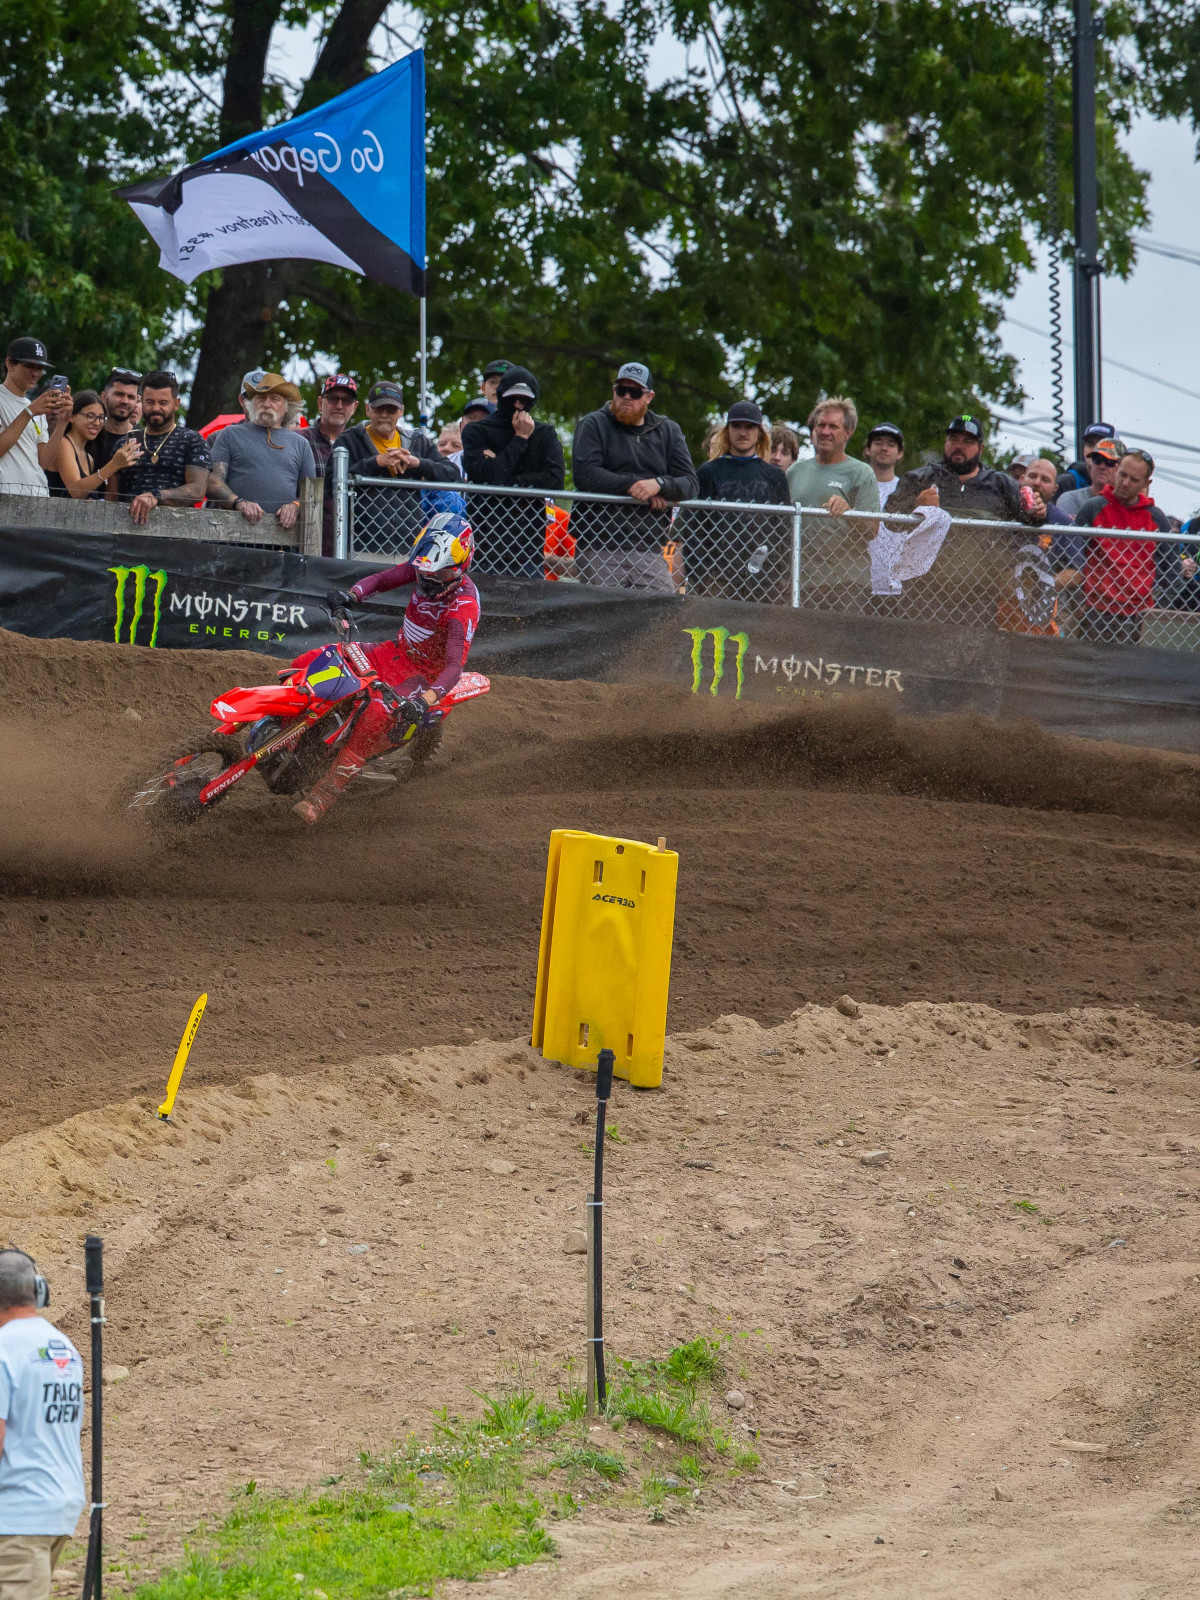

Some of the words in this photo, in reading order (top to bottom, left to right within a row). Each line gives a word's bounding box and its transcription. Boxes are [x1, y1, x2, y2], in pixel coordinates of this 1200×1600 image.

[35, 343, 44, 357] LA
[190, 623, 285, 642] ENERGY
[307, 666, 345, 687] 1
[206, 769, 245, 799] DUNLOP
